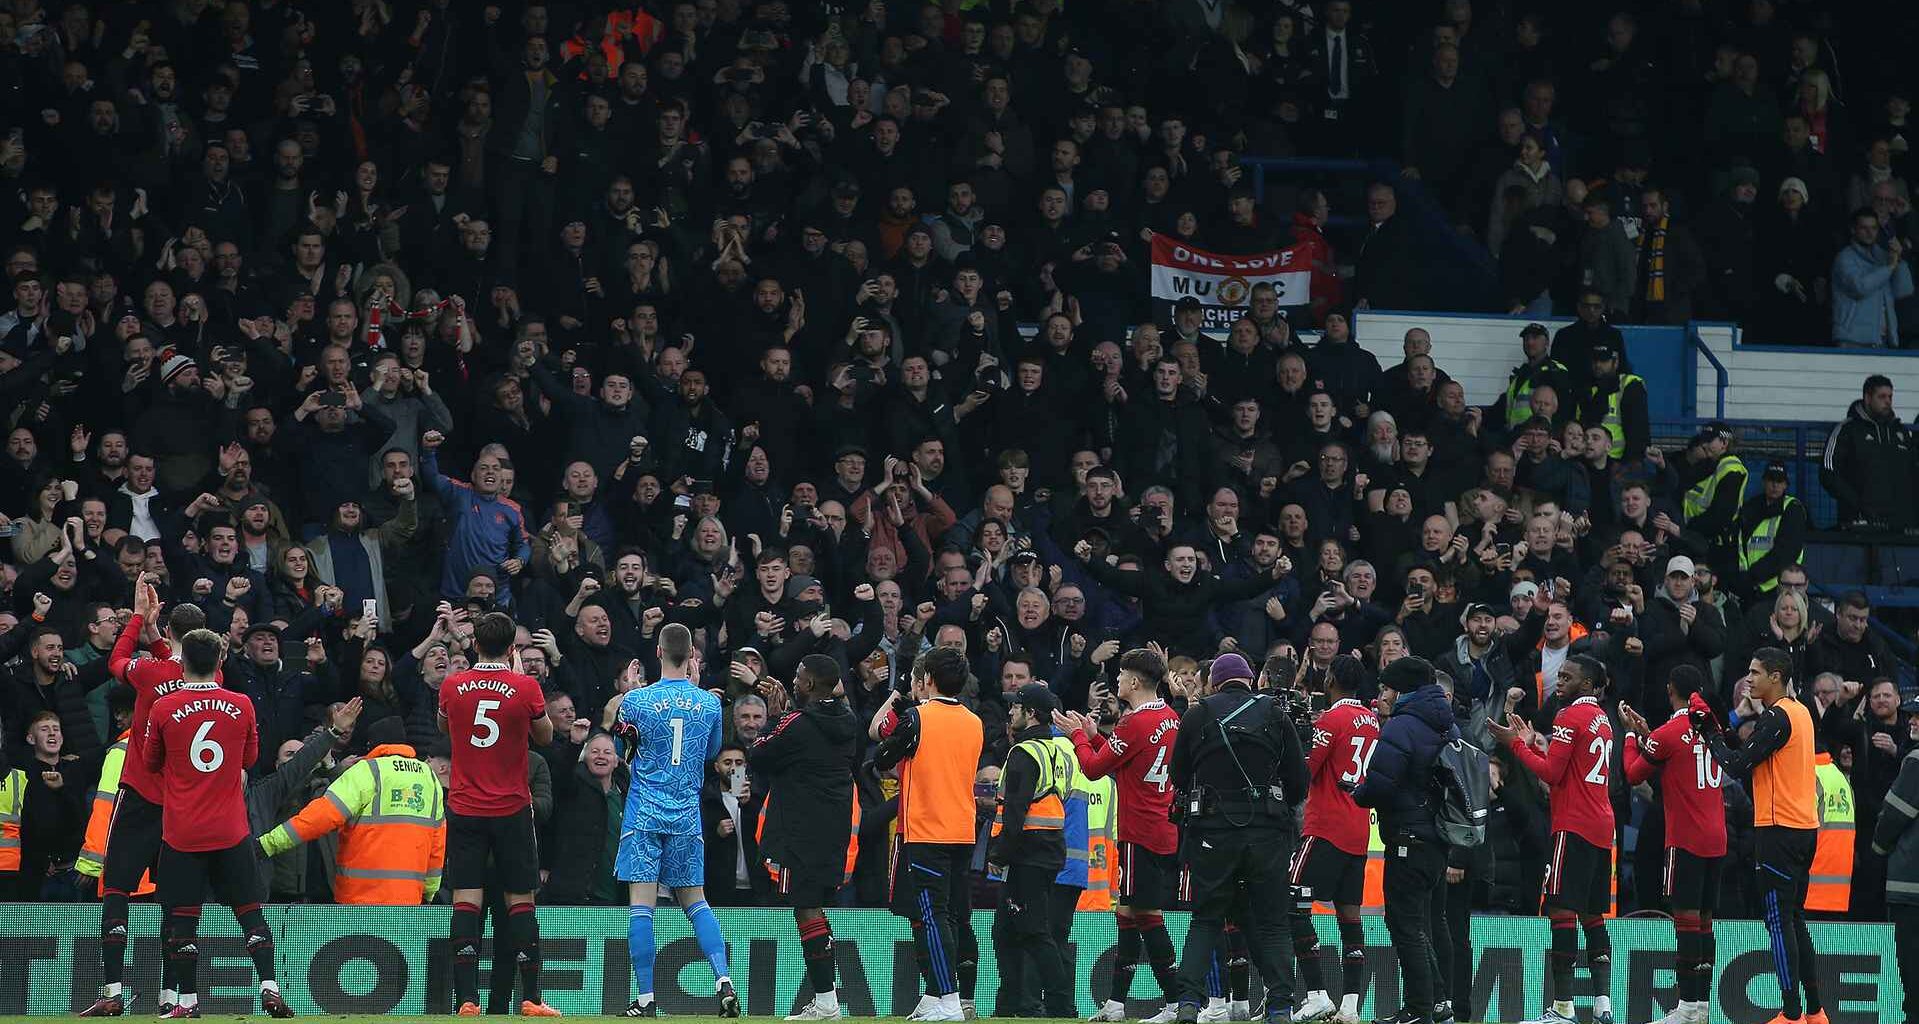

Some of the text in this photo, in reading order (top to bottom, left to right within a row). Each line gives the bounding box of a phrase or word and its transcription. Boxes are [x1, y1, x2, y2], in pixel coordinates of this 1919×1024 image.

[1173, 246, 1294, 269] ONE LOVE
[1173, 276, 1212, 296] MU
[456, 679, 517, 699] MAGUIRE
[653, 697, 702, 713] DE GEA
[171, 699, 242, 723] MARTINEZ
[470, 699, 501, 748] 5
[189, 720, 225, 773] 6
[669, 718, 684, 766] 1
[392, 760, 424, 773] SENIOR
[1143, 745, 1170, 793] 4
[1692, 743, 1723, 790] 10
[0, 936, 256, 1015] THE
